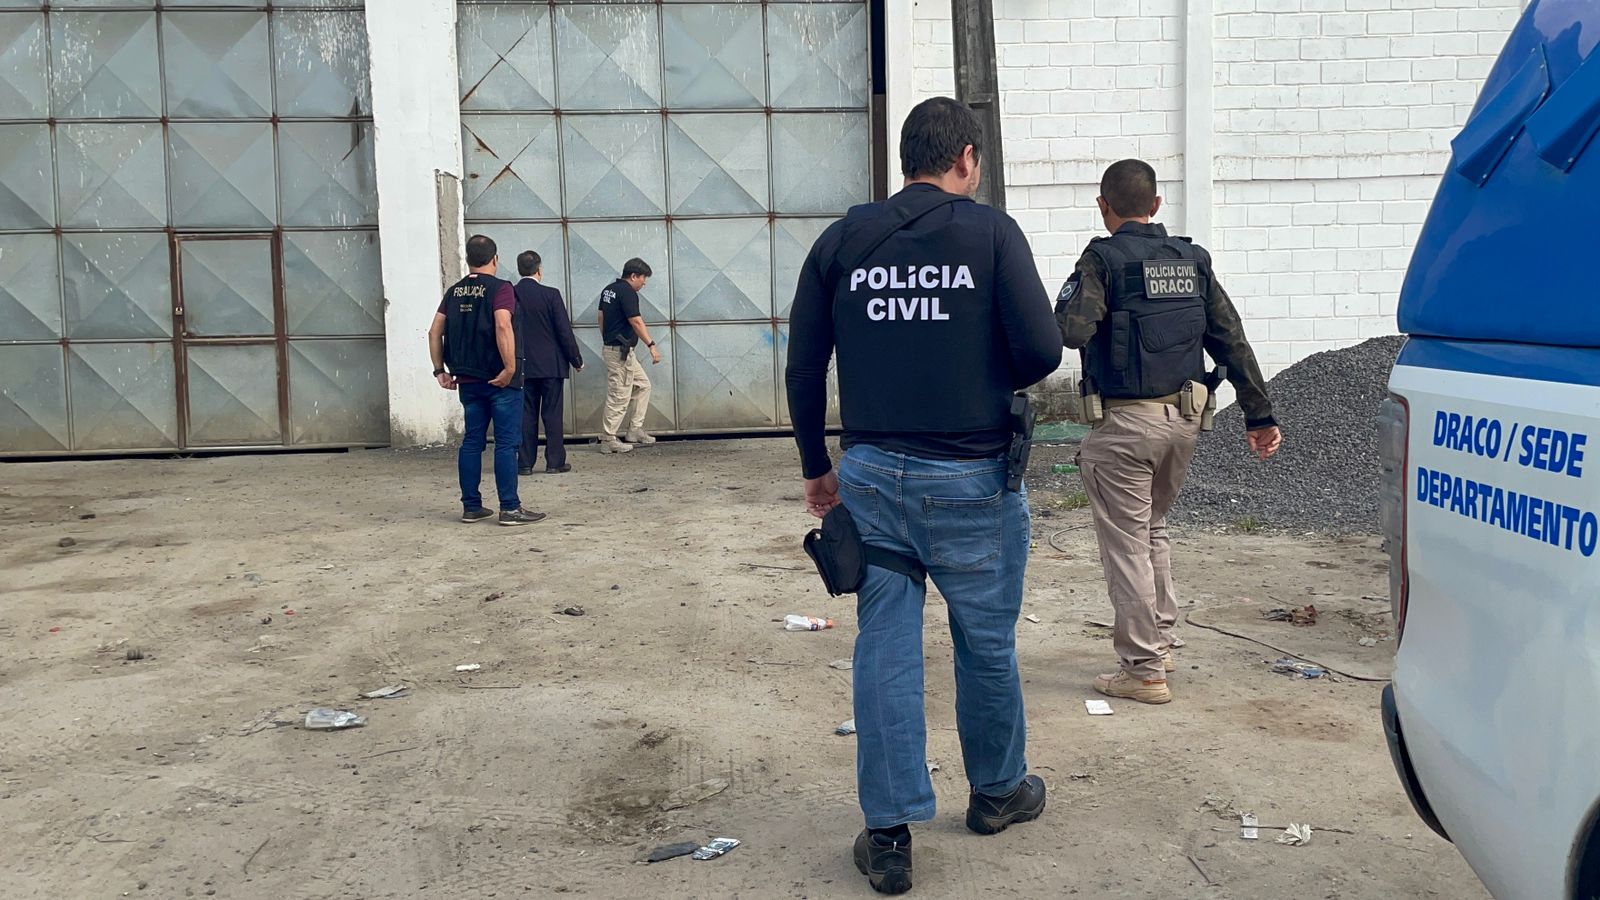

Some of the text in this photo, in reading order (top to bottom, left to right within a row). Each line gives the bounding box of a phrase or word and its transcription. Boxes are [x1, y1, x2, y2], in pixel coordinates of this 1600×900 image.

[850, 265, 975, 291] POLÍCIA
[1145, 264, 1196, 278] POLÍCIA CIVIL
[1150, 278, 1194, 294] DRACO
[867, 298, 950, 321] CIVIL
[1433, 410, 1587, 478] DRACO / SEDE
[1417, 466, 1598, 557] DEPARTAMENTO
